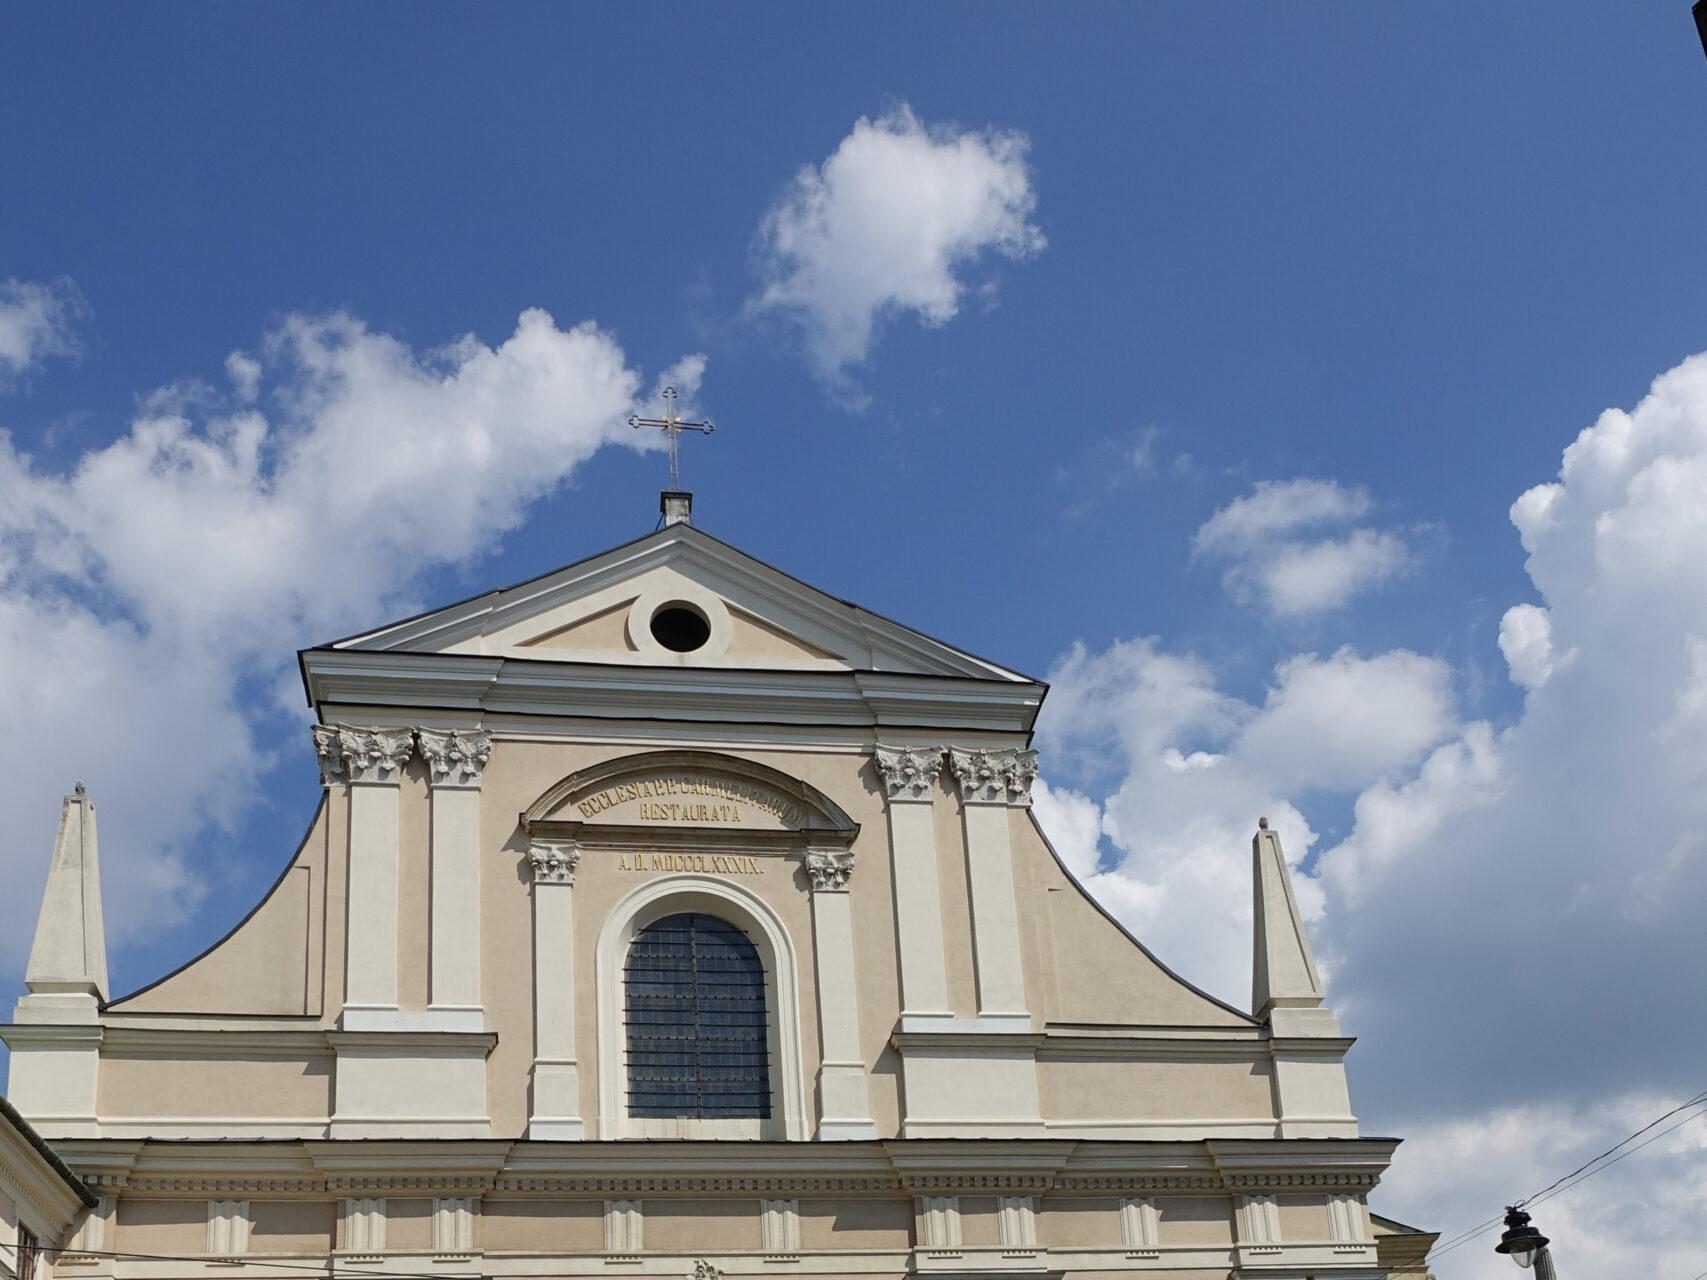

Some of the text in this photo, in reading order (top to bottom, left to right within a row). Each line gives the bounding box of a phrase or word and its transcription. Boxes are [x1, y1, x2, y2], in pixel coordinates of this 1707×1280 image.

[578, 781, 653, 818] ECCLESIA
[680, 779, 804, 827] CARMELITARUM
[640, 803, 741, 822] RESTAURATA
[618, 853, 631, 871] A.
